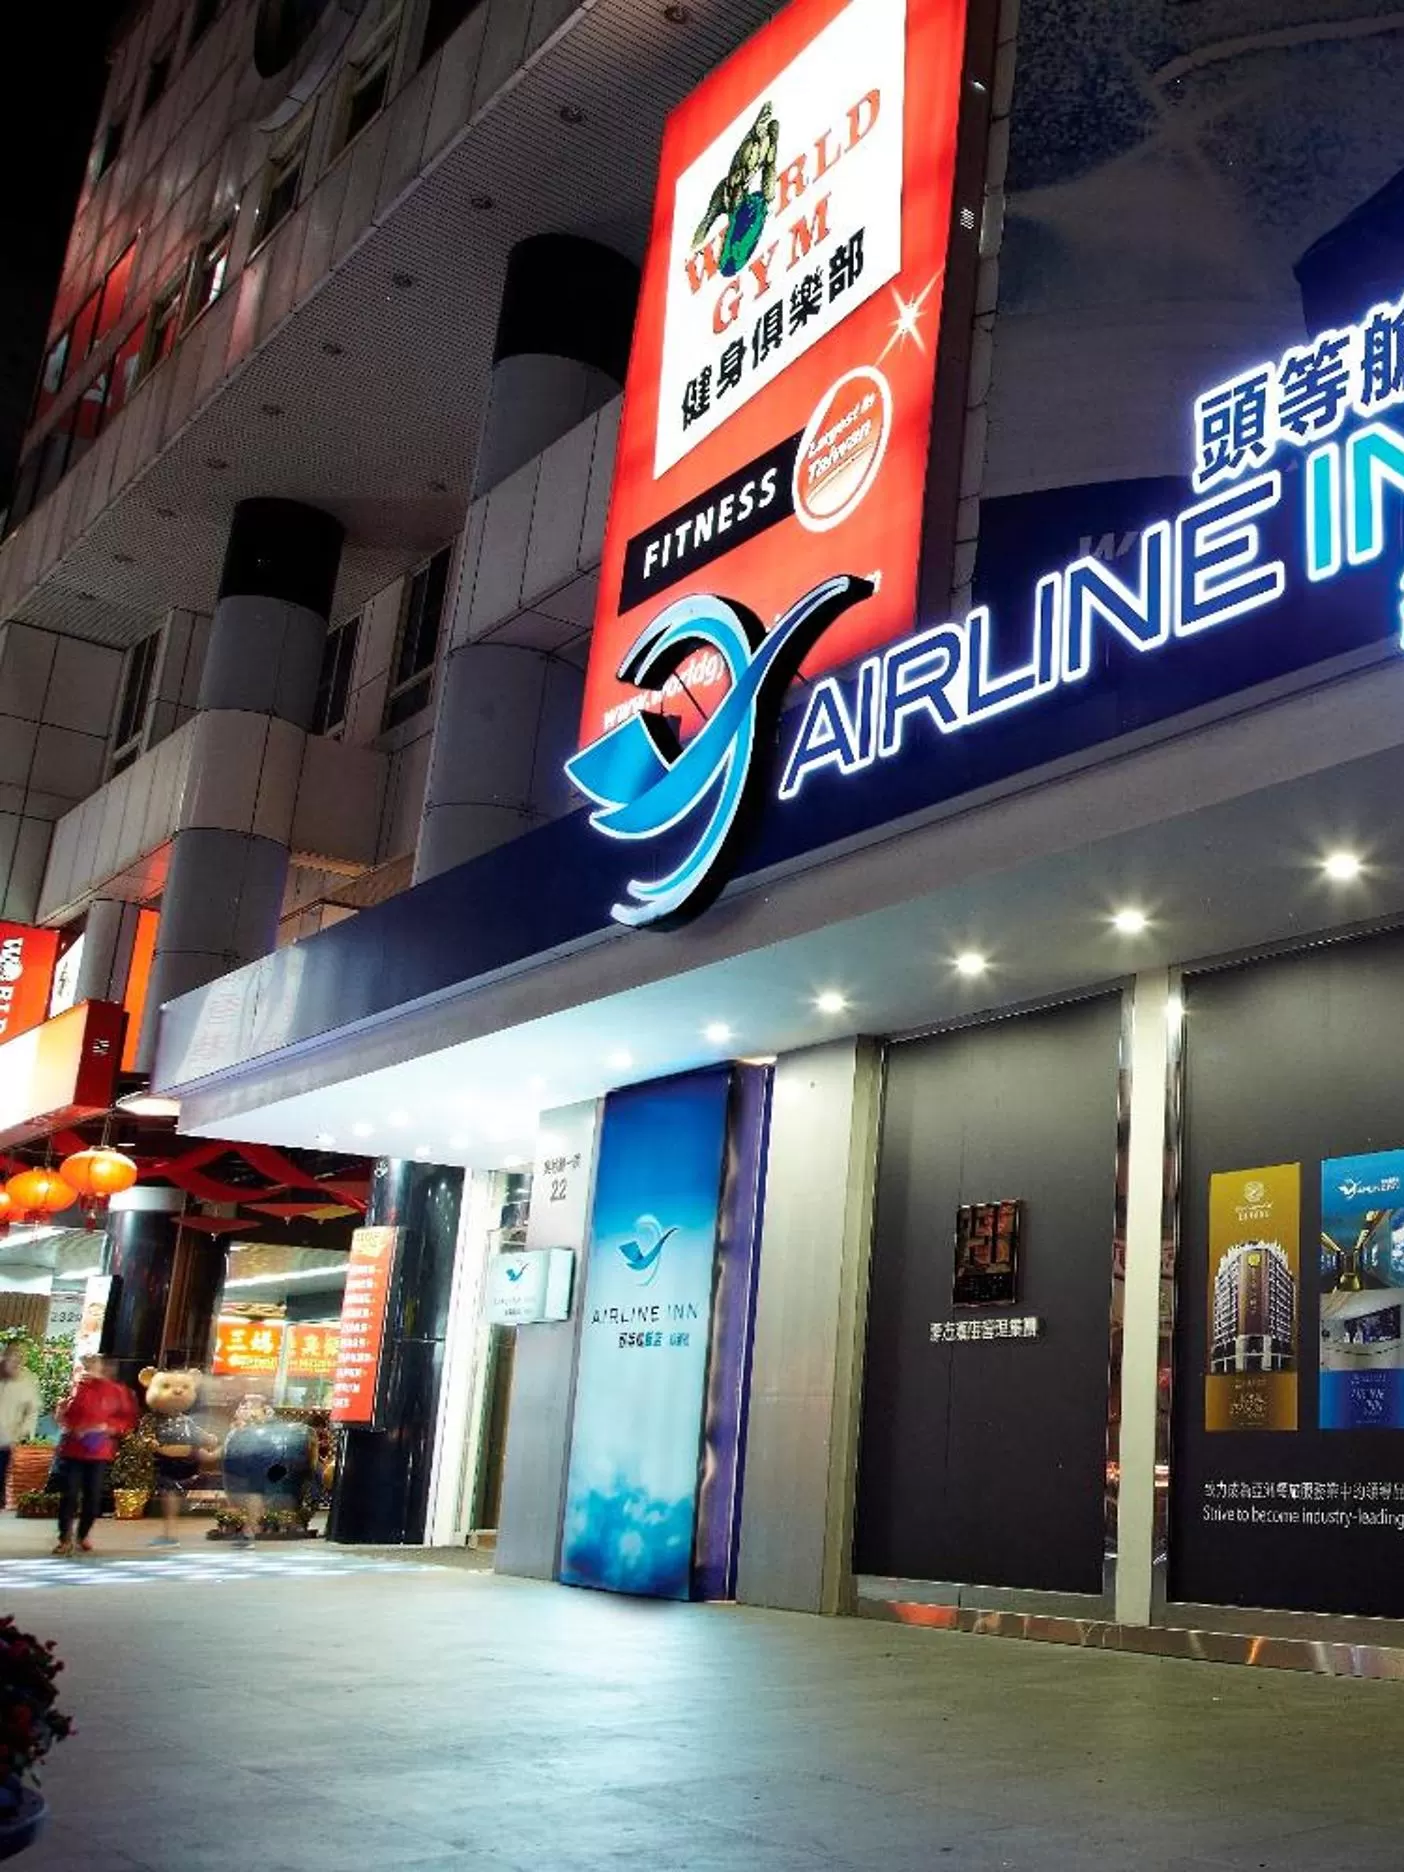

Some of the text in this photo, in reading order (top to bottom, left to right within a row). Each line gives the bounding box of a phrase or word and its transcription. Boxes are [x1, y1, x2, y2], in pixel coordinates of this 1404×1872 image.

[712, 191, 833, 335] GYM
[683, 226, 866, 431] 健身俱樂部
[642, 466, 779, 580] FITNESS
[778, 468, 1285, 800] AIRLINE
[550, 1178, 567, 1201] 22
[591, 1303, 698, 1324] AIRLINE INN
[1203, 1504, 1235, 1521] Strive
[1237, 1507, 1250, 1521] to
[1252, 1504, 1300, 1523] become
[1302, 1507, 1404, 1530] industry-leading
